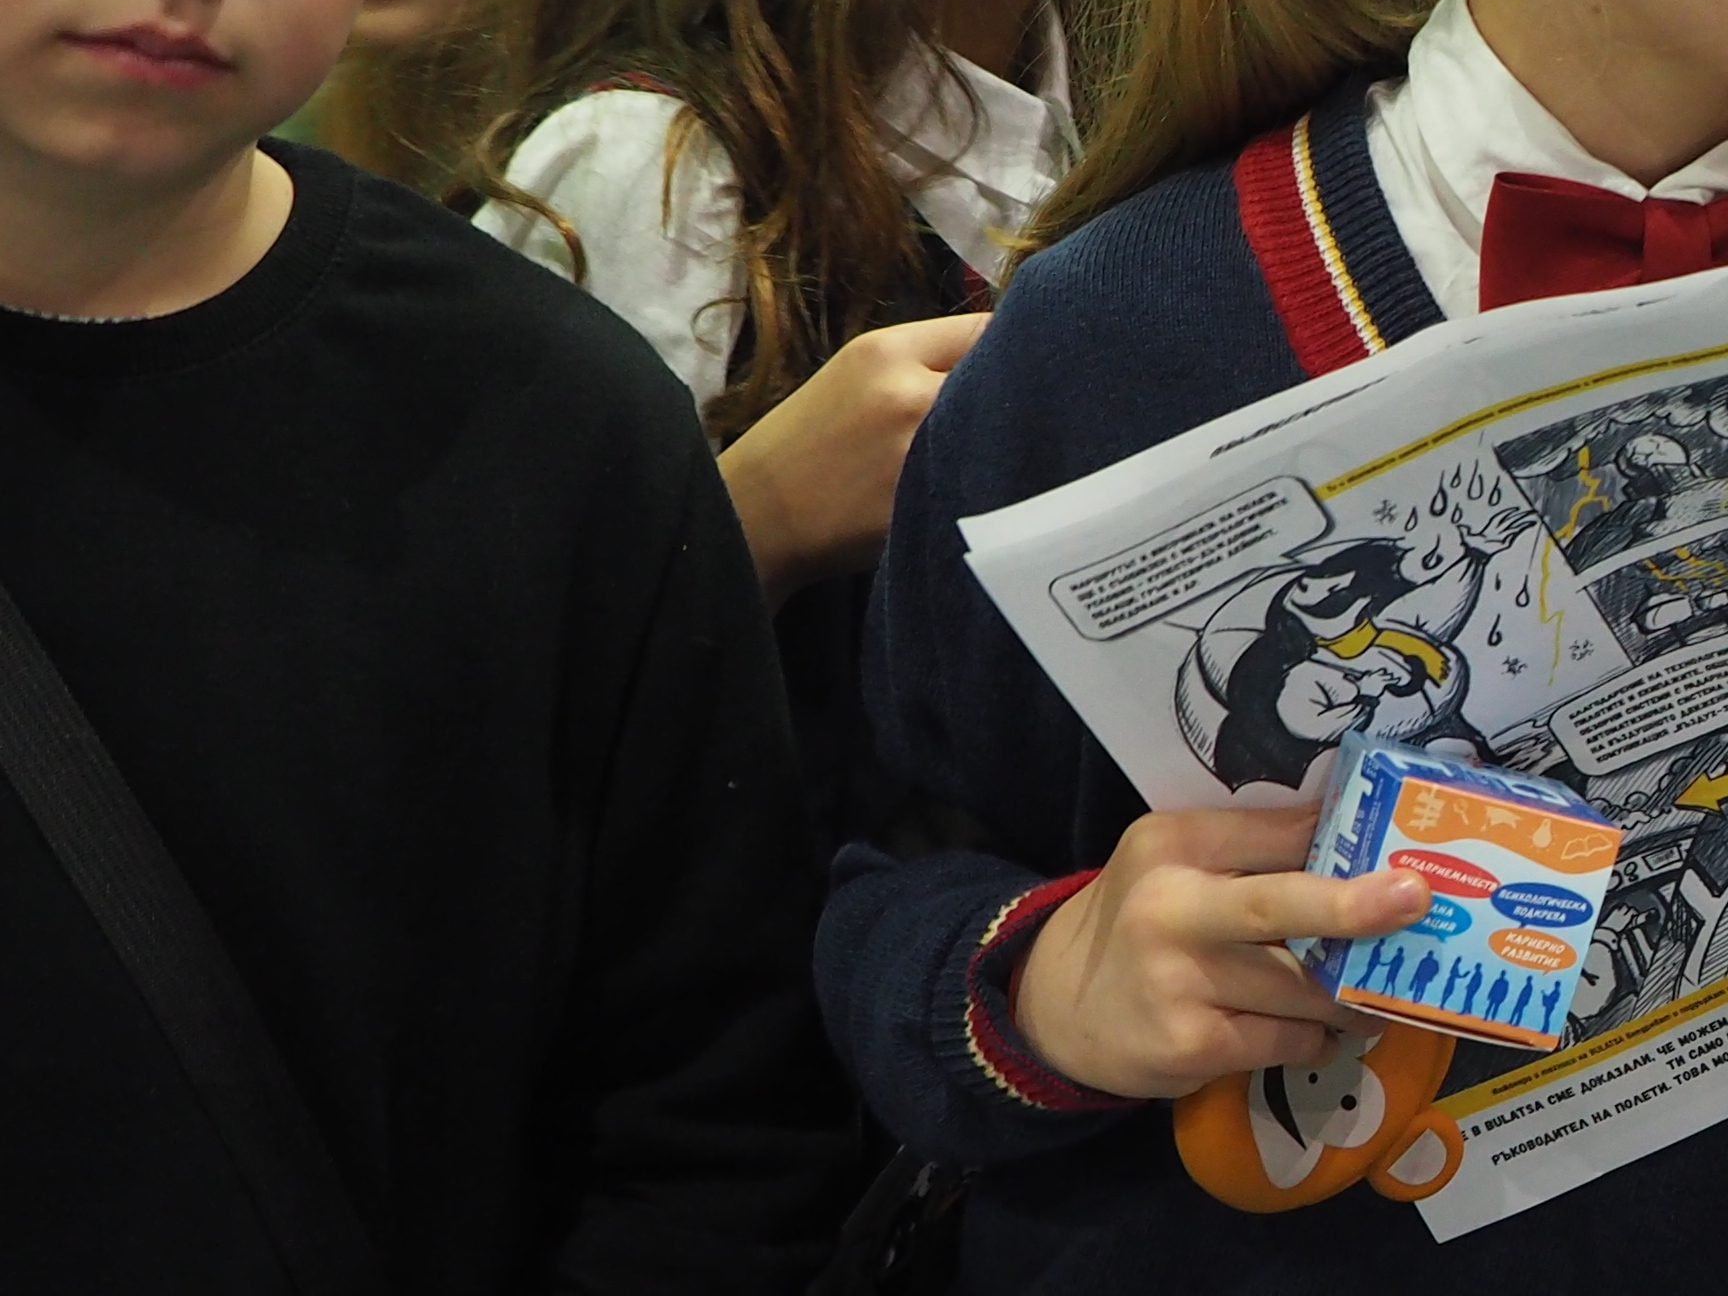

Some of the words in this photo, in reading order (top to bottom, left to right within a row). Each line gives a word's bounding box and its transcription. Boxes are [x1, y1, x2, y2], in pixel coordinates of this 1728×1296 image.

[1646, 670, 1662, 682] НА
[1675, 681, 1724, 707] СИСТЕМА
[1497, 886, 1587, 913] ПСИХОЛОГИЧЕСКА
[1512, 903, 1567, 923] ПОДКРЕПА
[1504, 931, 1566, 955] КАРИЕРНО
[1500, 945, 1562, 968] РАЗВИТИЕ
[1665, 1054, 1687, 1071] ТИ
[1686, 1036, 1725, 1061] САМО
[1470, 1124, 1482, 1137] В
[1483, 1098, 1545, 1132] BULATSA
[1546, 1085, 1576, 1106] СМЕ
[1577, 1050, 1656, 1095] ДОКАЗАЛИ,
[1656, 1041, 1676, 1057] ЧЕ
[1490, 1115, 1590, 1167] РЪКОВОДИТЕЛ
[1590, 1106, 1613, 1125] НА
[1613, 1080, 1673, 1114] ПОЛЕТИ.
[1671, 1061, 1711, 1087] ТОВА
